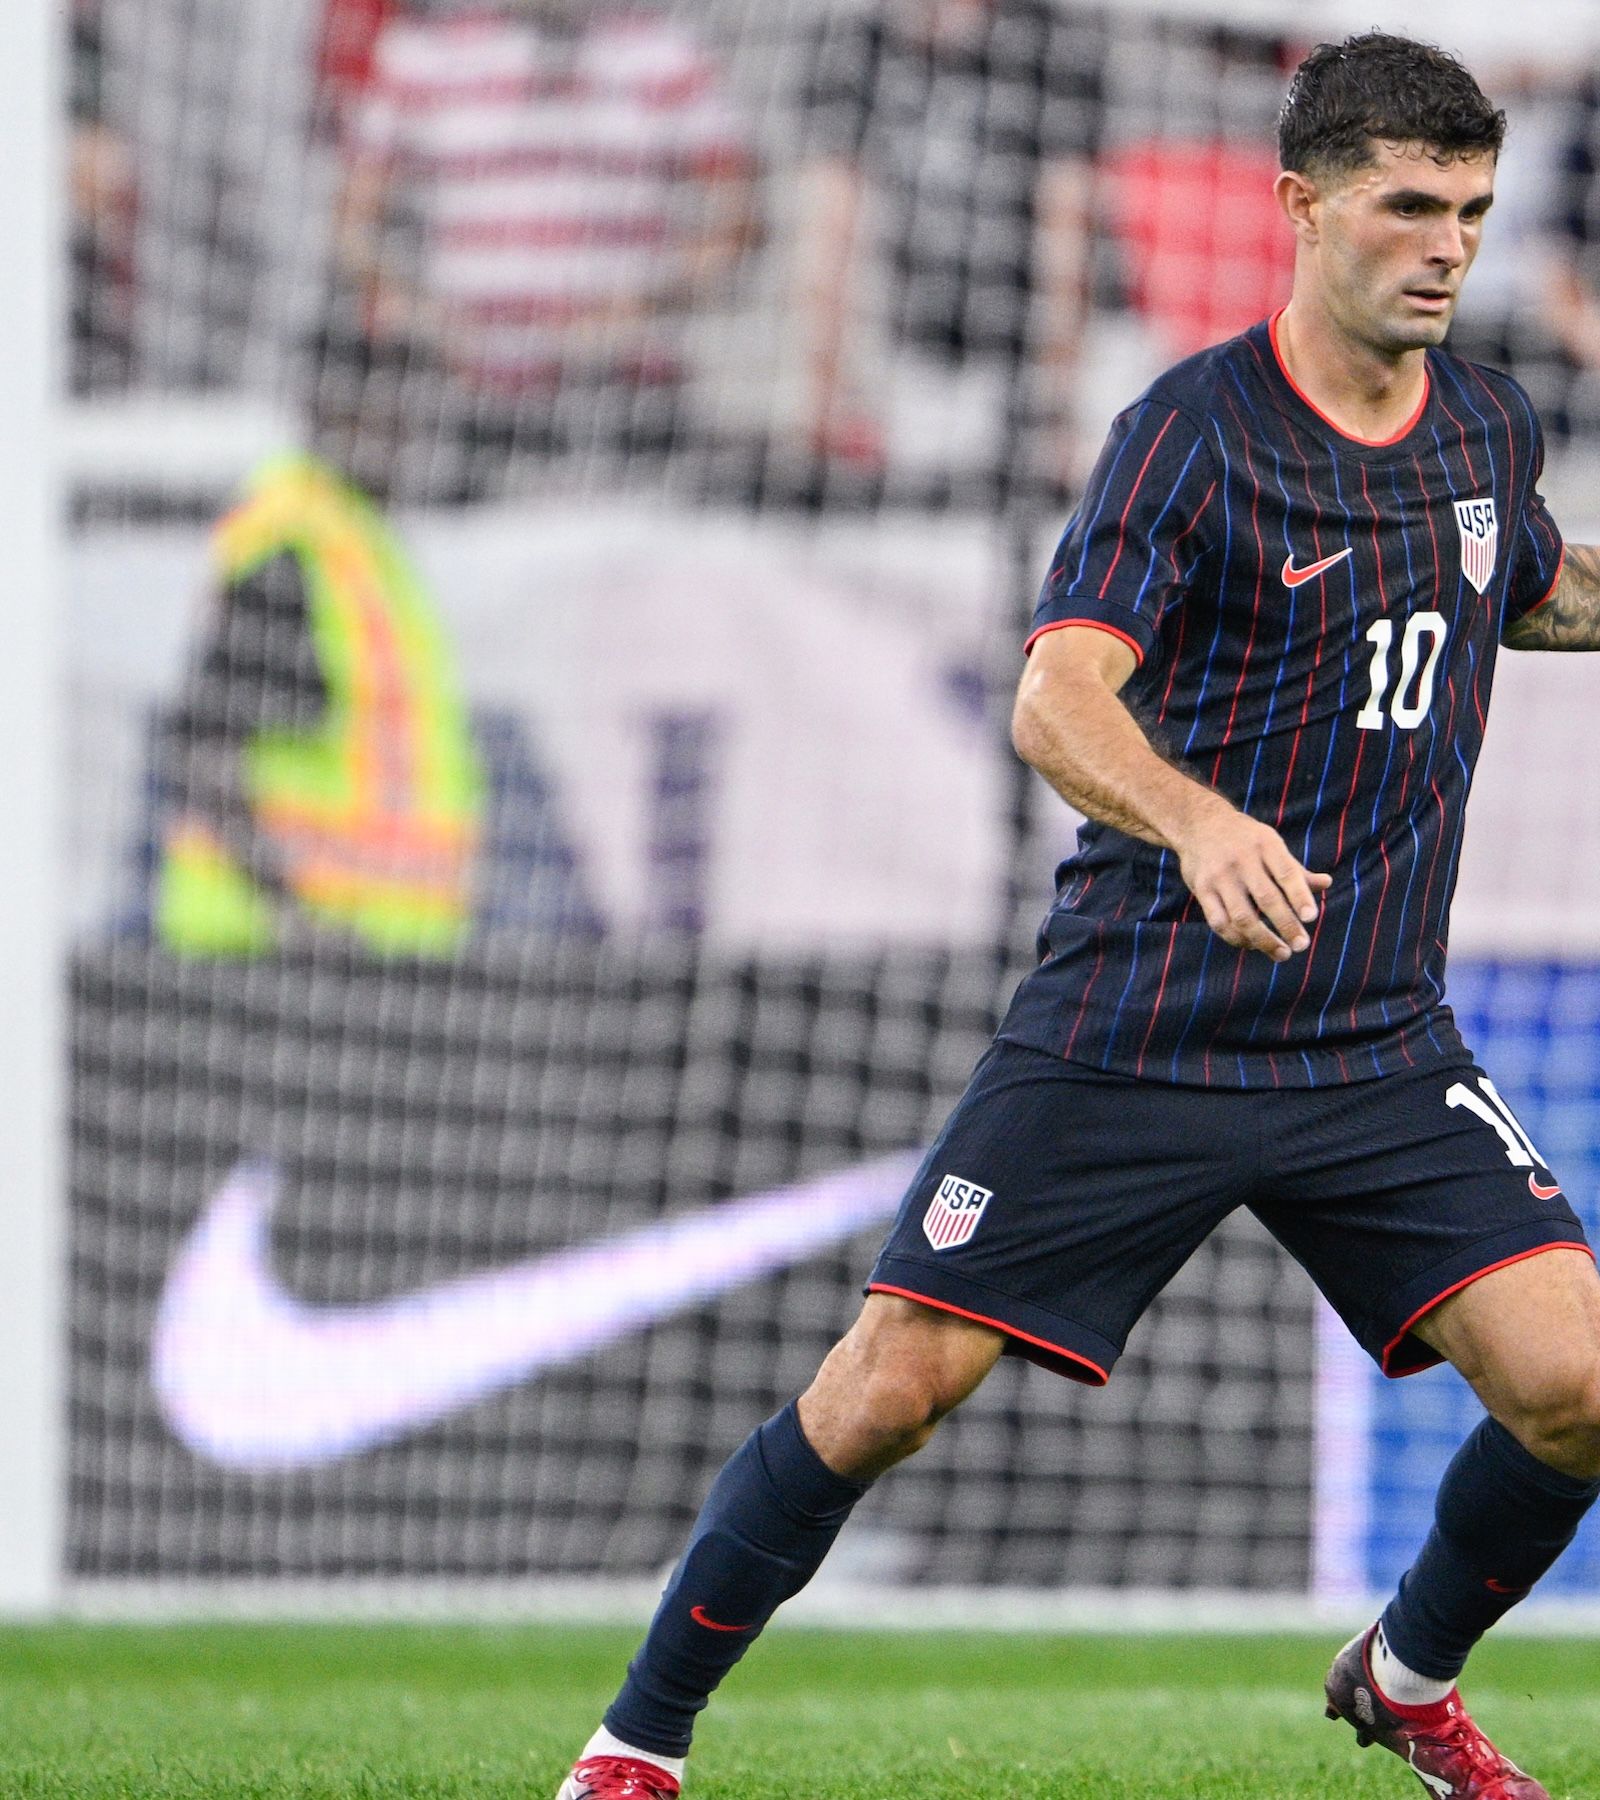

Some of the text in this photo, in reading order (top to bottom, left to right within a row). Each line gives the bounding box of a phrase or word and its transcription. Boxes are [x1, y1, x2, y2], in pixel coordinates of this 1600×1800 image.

[1458, 503, 1494, 539] USA
[1356, 611, 1447, 730] 10
[940, 1179, 986, 1210] USA
